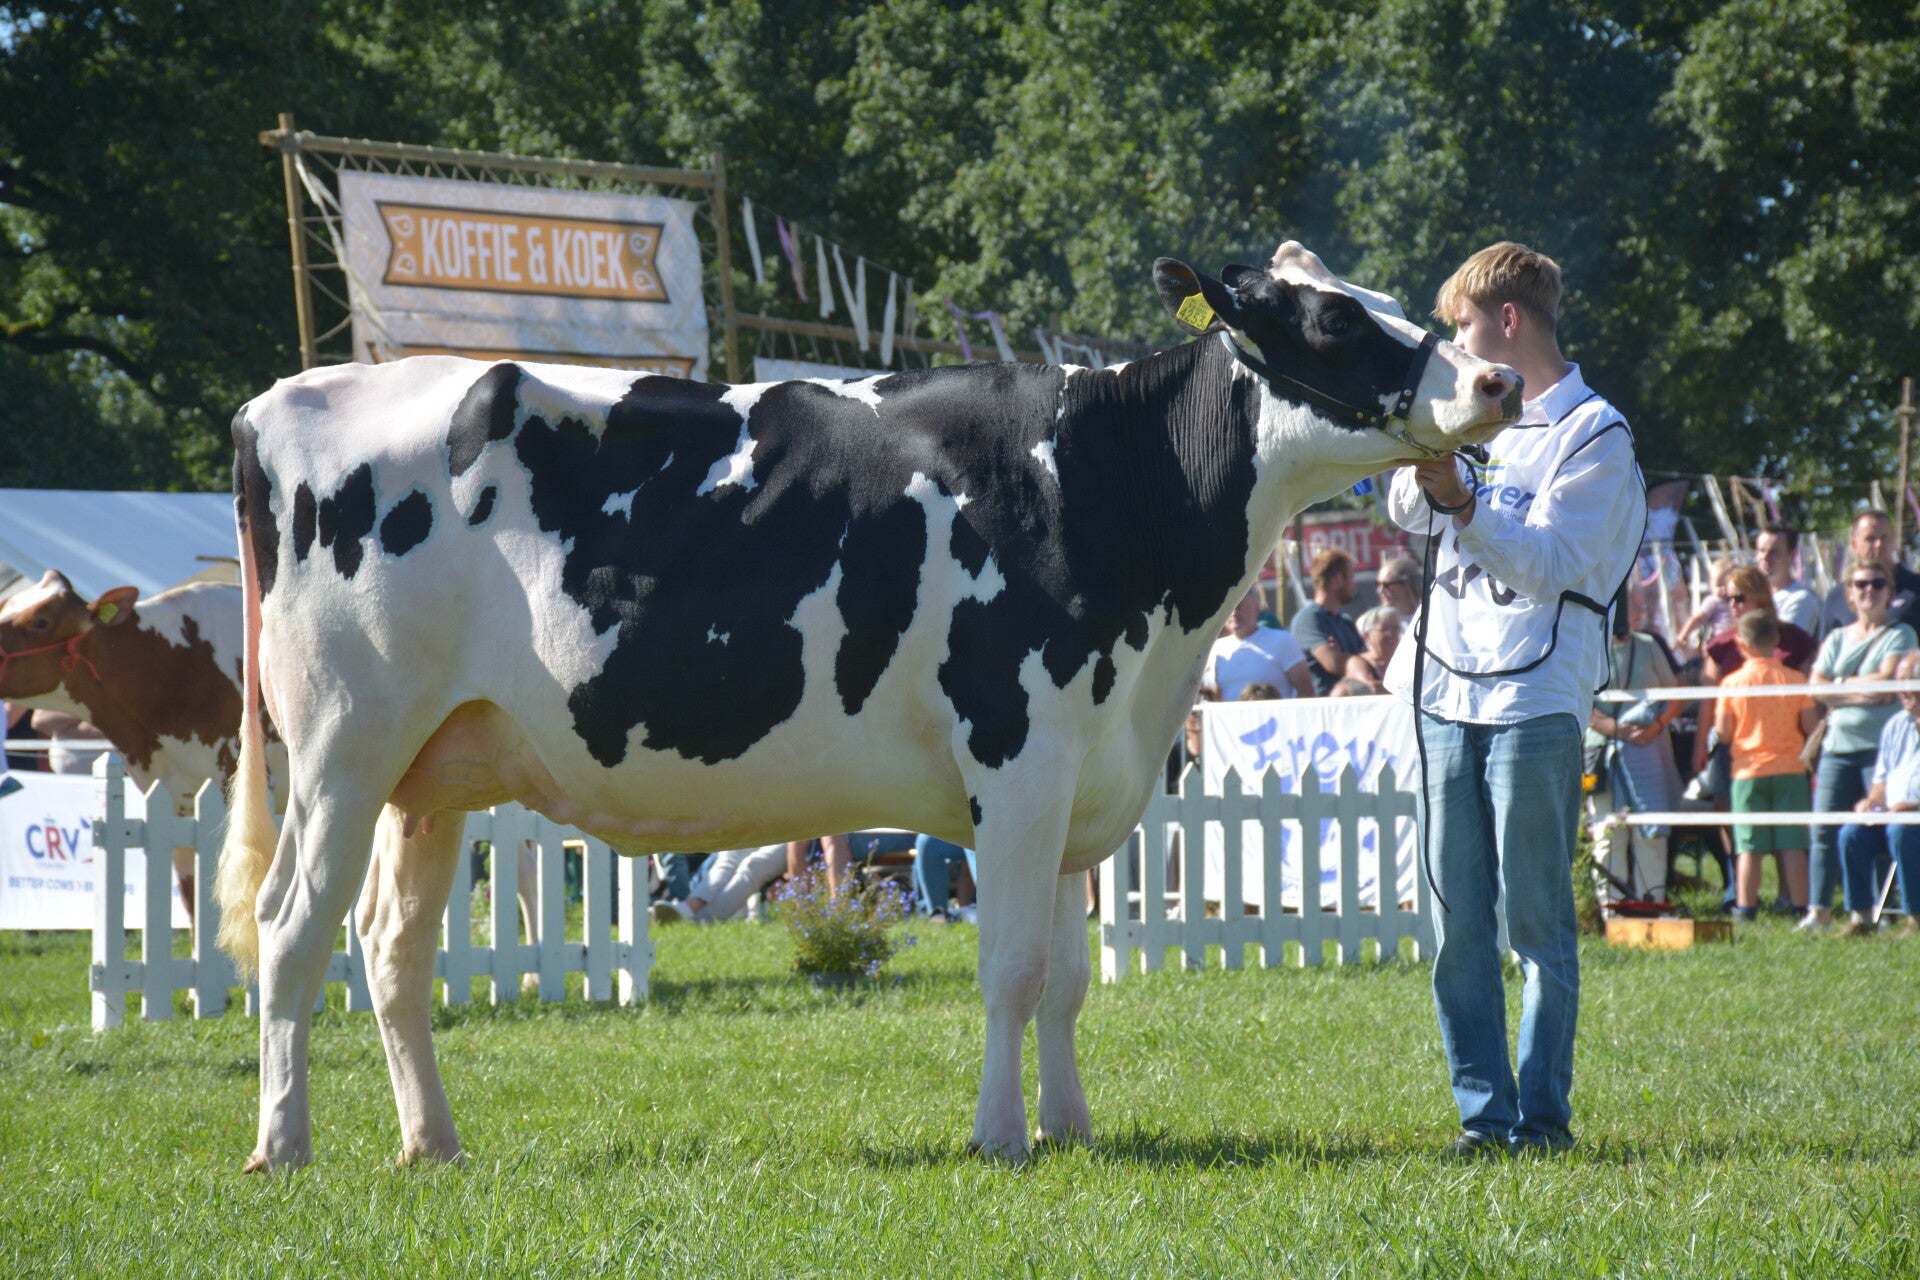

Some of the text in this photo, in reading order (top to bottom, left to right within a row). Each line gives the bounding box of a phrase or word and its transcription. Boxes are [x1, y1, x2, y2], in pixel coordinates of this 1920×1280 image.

[421, 217, 629, 290] KOFFIE & KOEK
[25, 823, 80, 860] CRV
